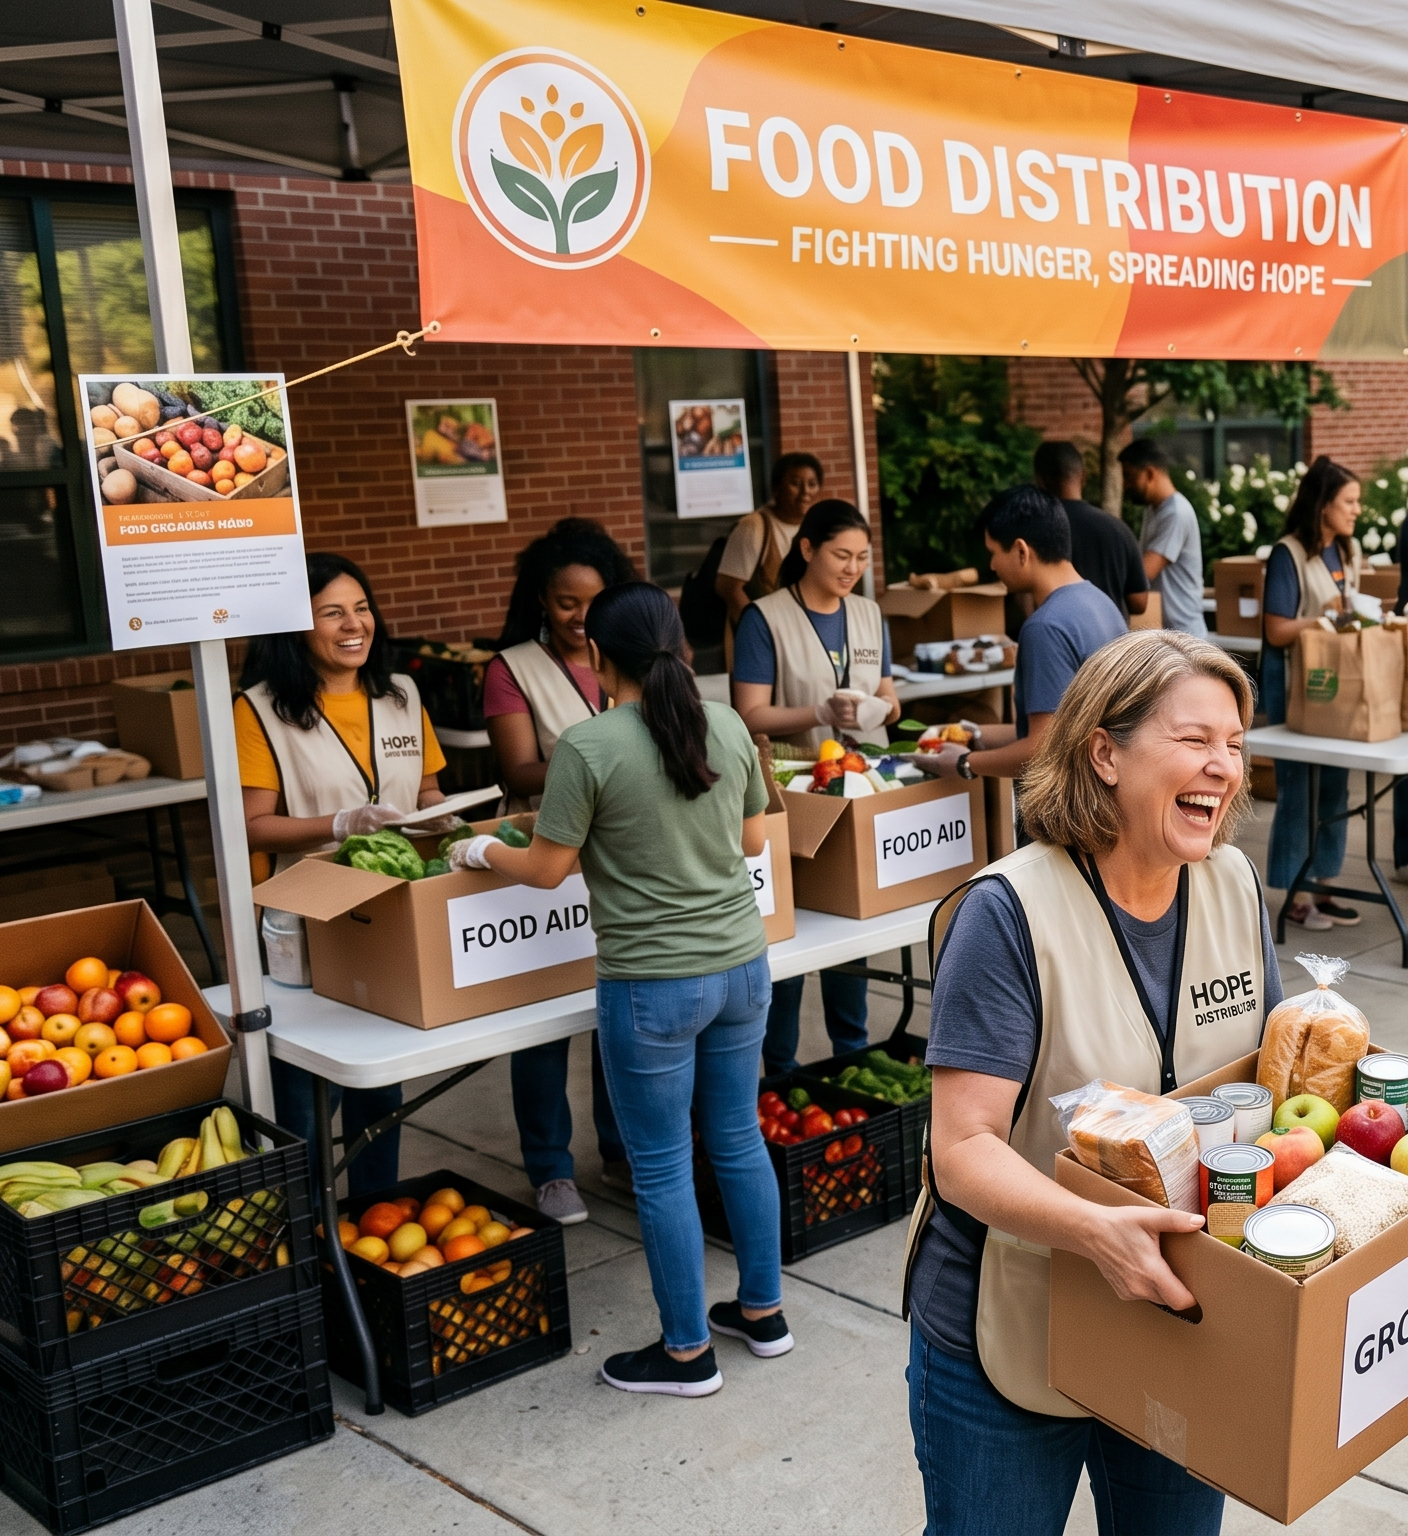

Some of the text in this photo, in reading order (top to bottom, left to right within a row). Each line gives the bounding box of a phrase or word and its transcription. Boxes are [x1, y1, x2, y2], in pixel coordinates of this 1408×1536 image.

[705, 107, 1373, 249] FOOD DISTRIBUTION
[792, 226, 1326, 296] FIGHTING HUNGER, SPREADING HOPE
[882, 819, 966, 860] FOOD AID
[462, 904, 589, 953] FOOD AID
[1190, 970, 1254, 1009] HOPE
